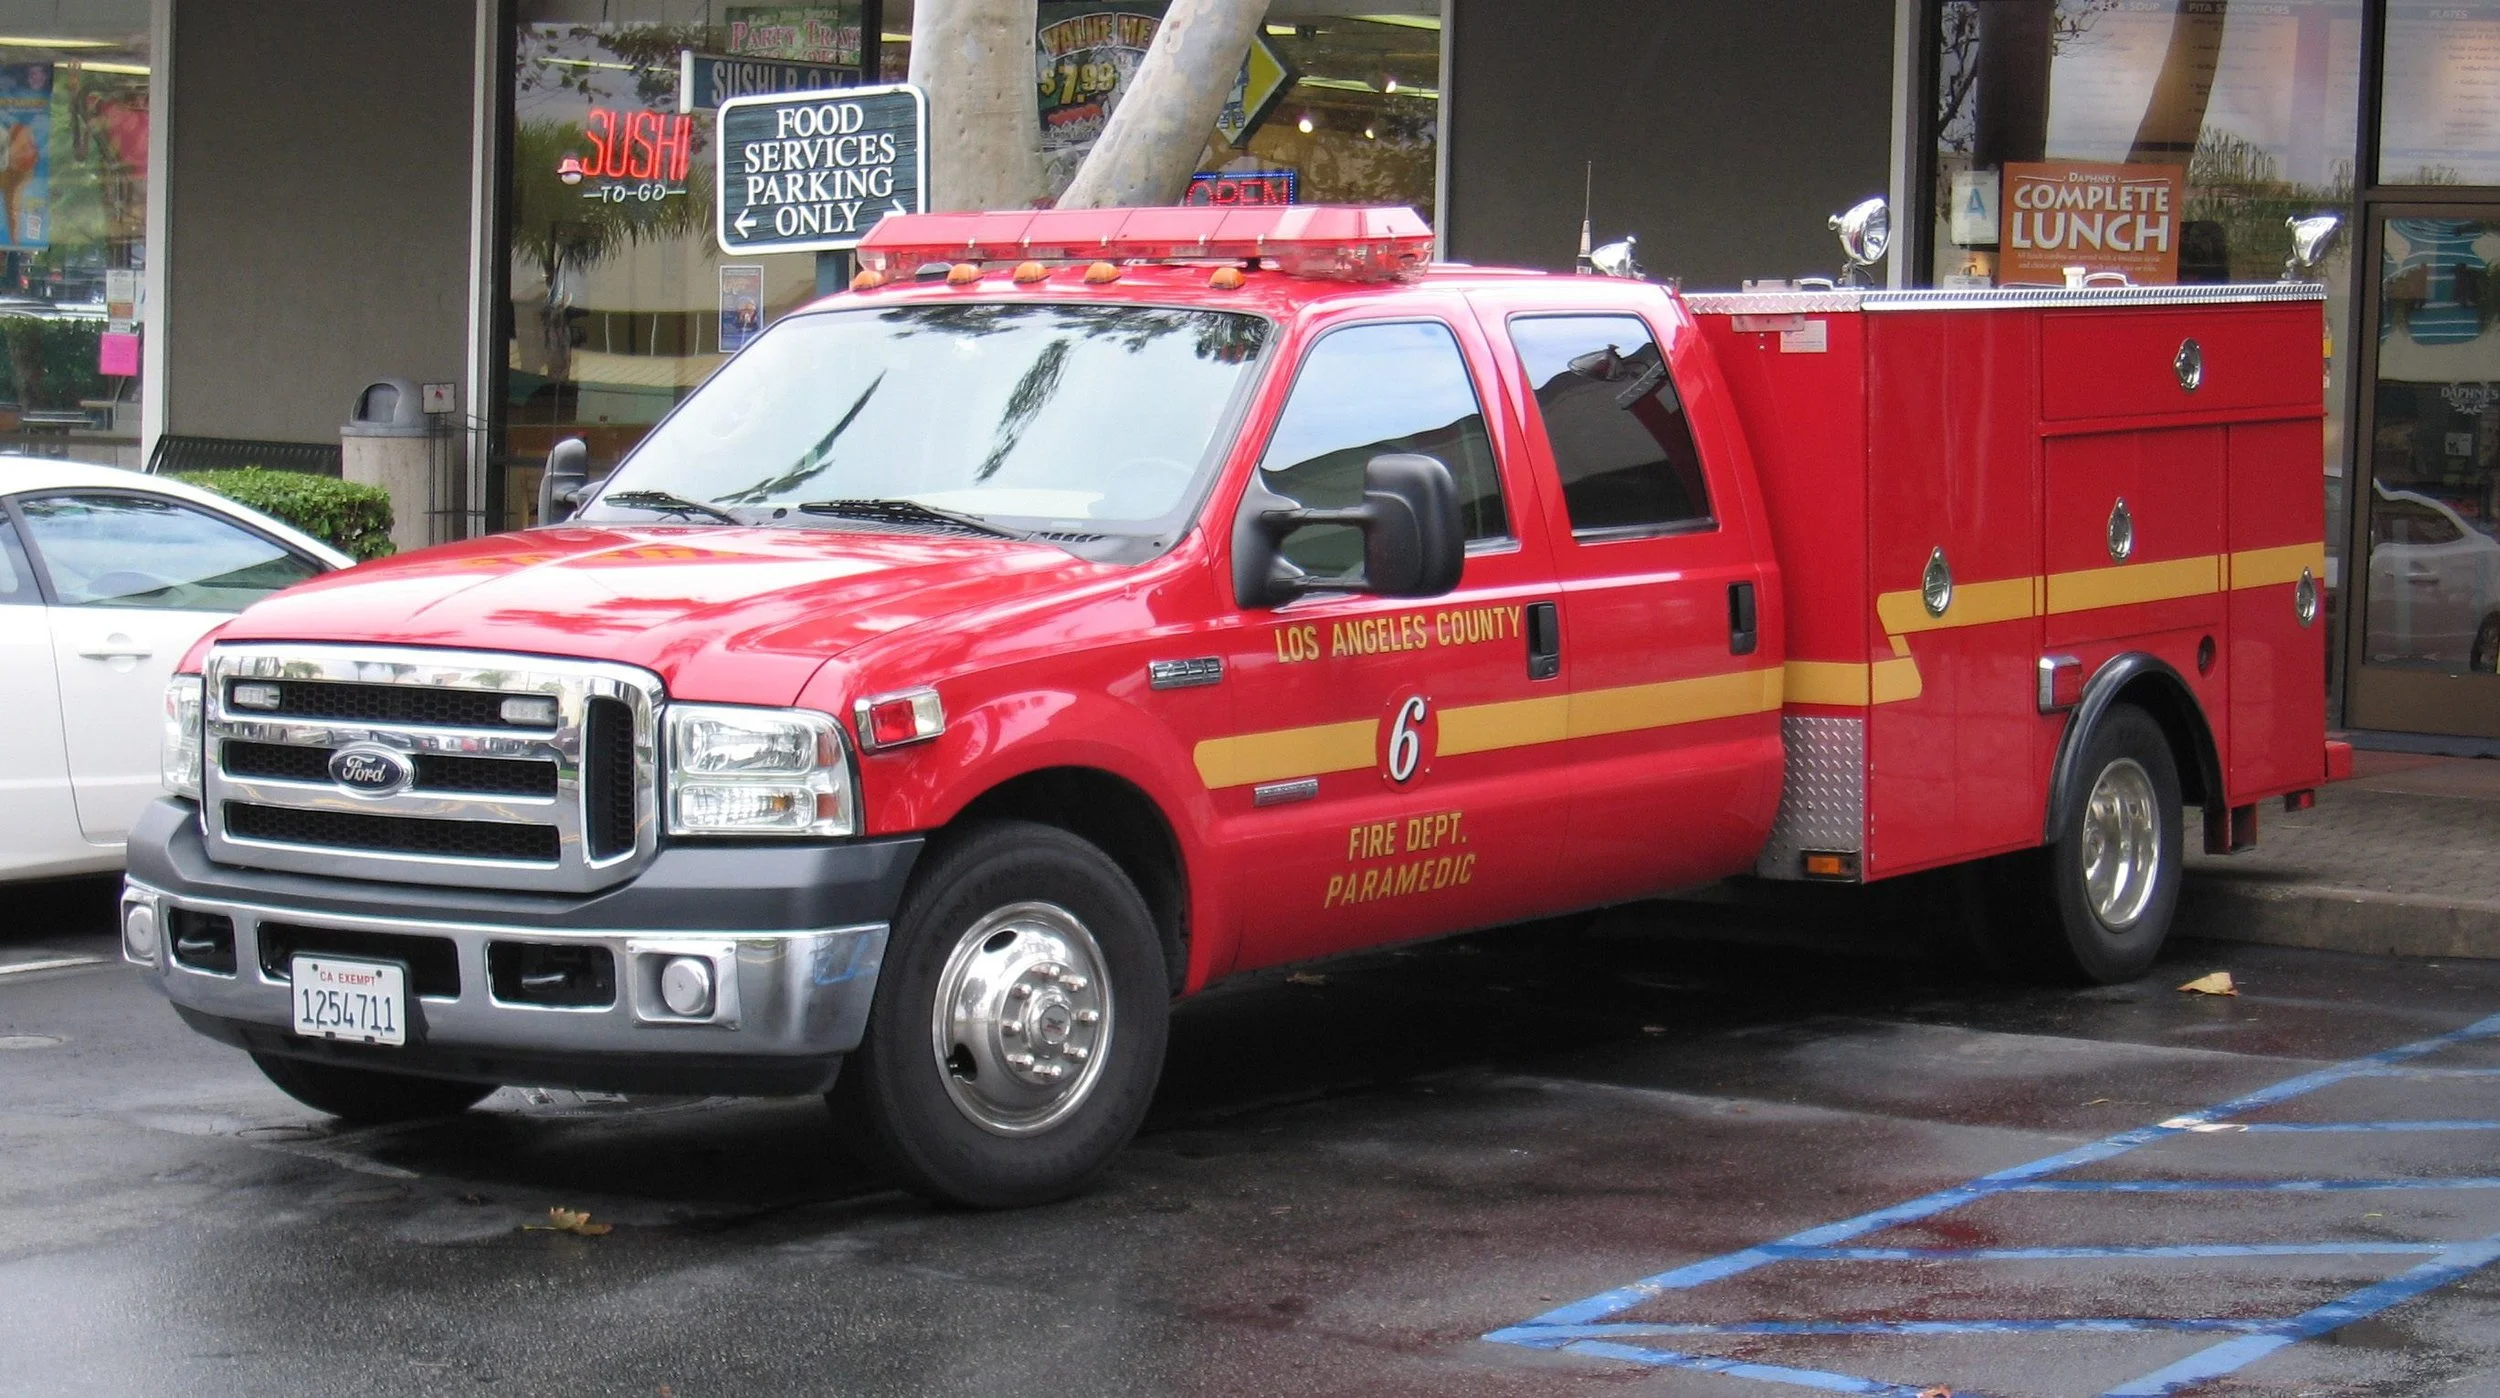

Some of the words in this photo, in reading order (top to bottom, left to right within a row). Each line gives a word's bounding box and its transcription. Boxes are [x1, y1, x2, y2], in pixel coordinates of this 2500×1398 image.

[2189, 3, 2212, 13] PITA
[731, 21, 796, 50] PARTY
[1043, 14, 1113, 56] VALUE
[712, 60, 777, 107] SUSHI
[1039, 62, 1116, 105] $7.99
[776, 103, 864, 139] FOOD
[582, 107, 692, 181] SUSHI
[744, 133, 897, 174] SERVICES
[601, 183, 666, 204] TO-GO
[745, 166, 895, 207] PARKING
[1184, 180, 1290, 207] OPEN
[1963, 187, 1987, 221] A
[2013, 183, 2171, 213] COMPLETE
[775, 201, 864, 237] ONLY
[2011, 211, 2169, 252] LUNCH
[1275, 625, 1320, 663] LOS
[1332, 614, 1428, 657] ANGELES
[1436, 605, 1521, 648] COUNTY
[1388, 696, 1427, 784] 6
[342, 755, 387, 782] Ford
[1348, 821, 1397, 862] FIRE
[1406, 811, 1468, 853] DEPT.
[1323, 852, 1477, 909] PARAMEDIC
[320, 971, 333, 982] CA
[338, 973, 375, 986] EXEMPT
[302, 987, 396, 1036] 1254711
